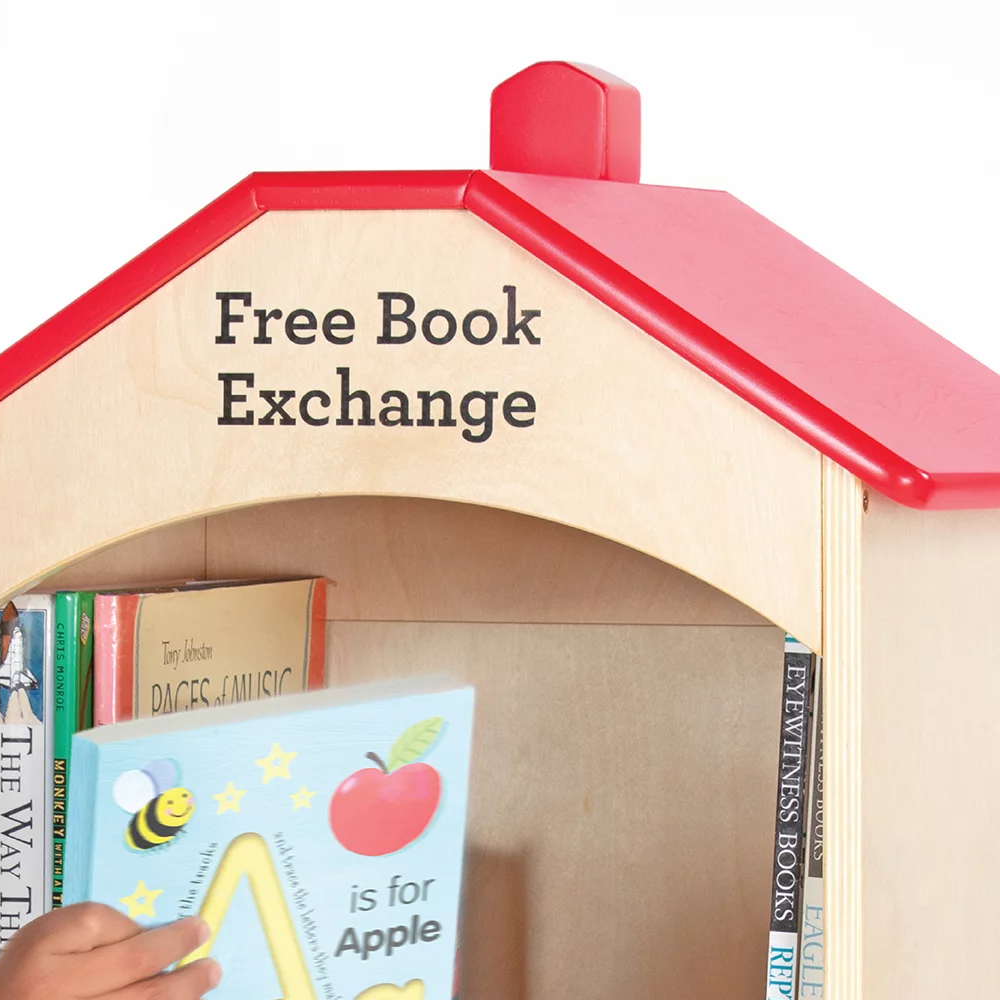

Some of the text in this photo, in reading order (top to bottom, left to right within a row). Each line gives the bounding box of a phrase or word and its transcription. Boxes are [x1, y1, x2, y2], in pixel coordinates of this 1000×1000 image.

[215, 285, 541, 345] Free Book
[217, 367, 537, 443] Exchange
[56, 623, 65, 712] CHRIS MONROE
[162, 638, 213, 670] Tony Johnston
[152, 677, 211, 717] PAGES
[0, 726, 33, 793] THE
[53, 759, 66, 839] MONKEY
[775, 665, 807, 922] EYEWITNESS BOOKS
[0, 799, 33, 879] WAY
[53, 843, 63, 875] WITH
[53, 879, 63, 888] A
[349, 874, 436, 914] is for
[333, 914, 443, 961] Apple
[800, 904, 823, 997] EAGLE
